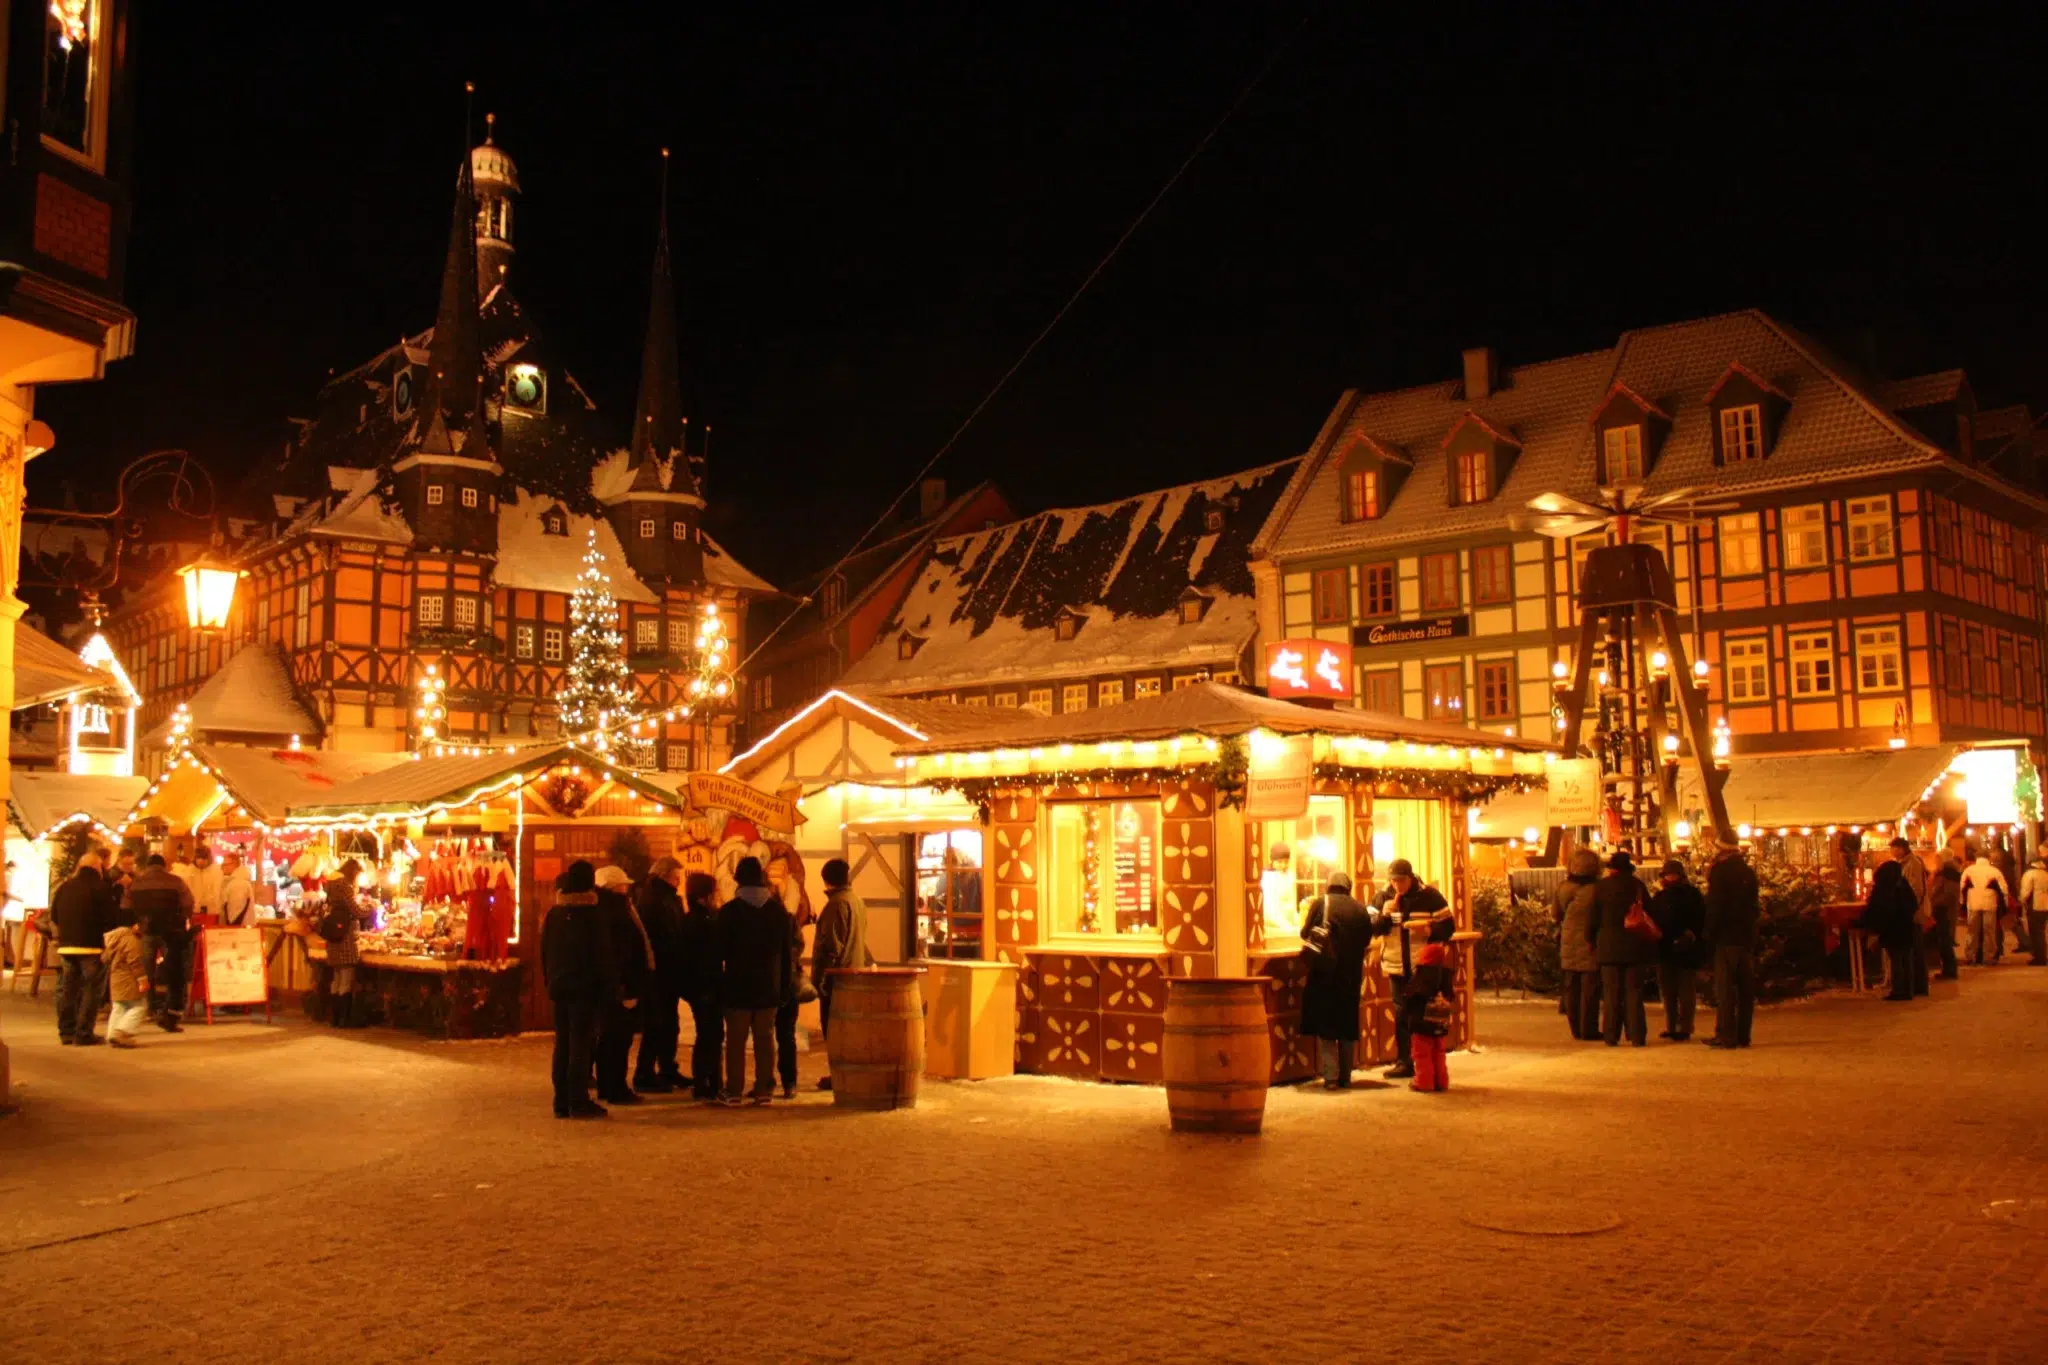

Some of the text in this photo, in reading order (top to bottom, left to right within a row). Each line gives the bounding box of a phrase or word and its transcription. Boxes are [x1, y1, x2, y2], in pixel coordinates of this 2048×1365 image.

[1369, 625, 1452, 643] Gothisches Haus
[698, 778, 785, 814] Weihnachtsmarkt
[709, 791, 770, 822] Wernigerode
